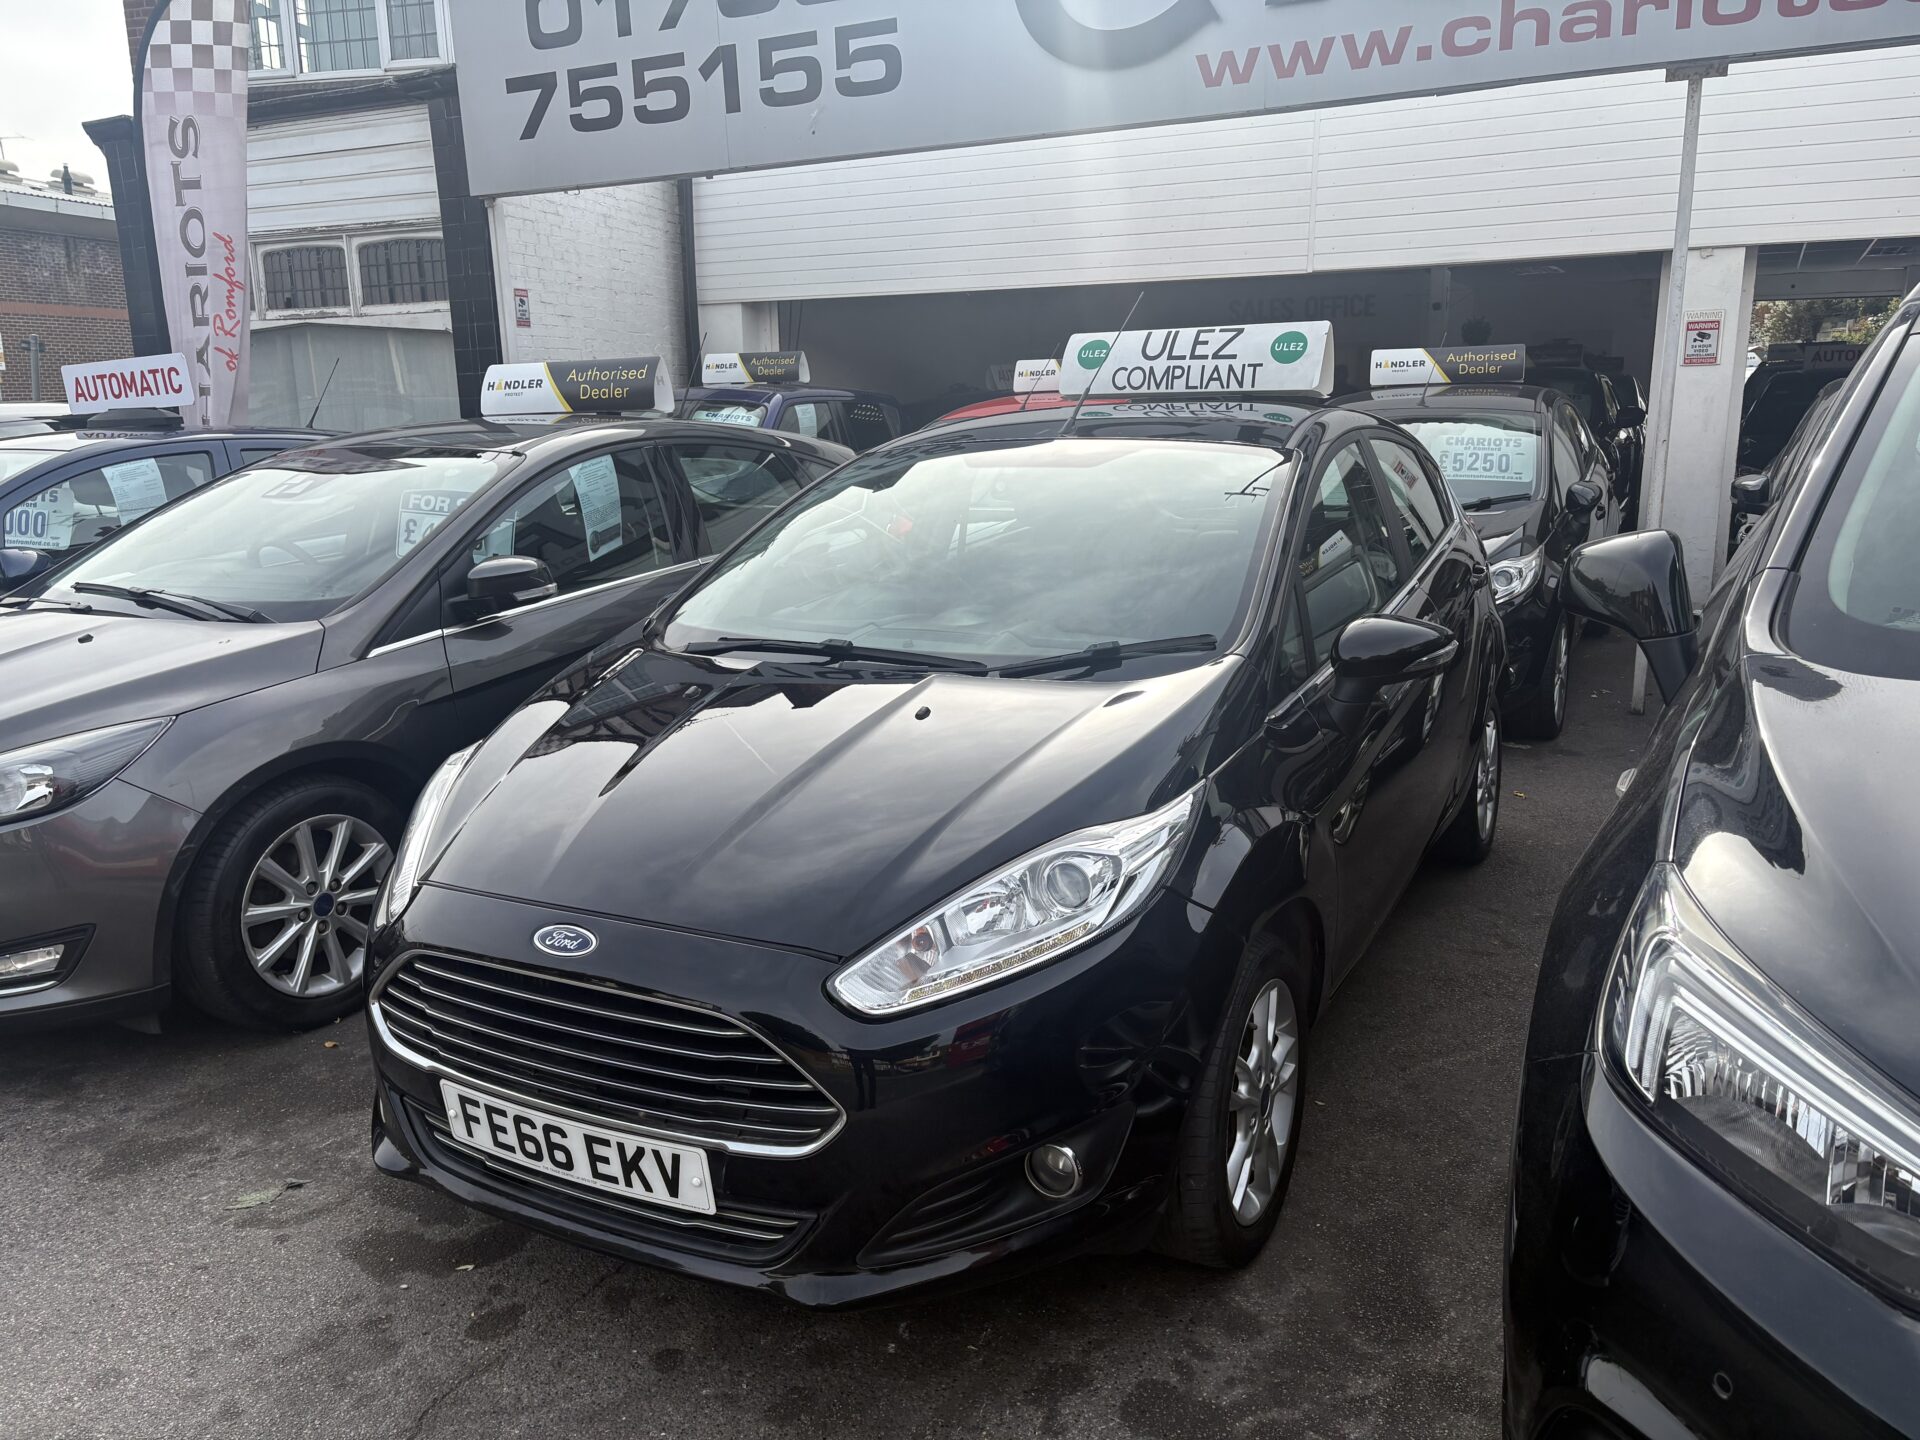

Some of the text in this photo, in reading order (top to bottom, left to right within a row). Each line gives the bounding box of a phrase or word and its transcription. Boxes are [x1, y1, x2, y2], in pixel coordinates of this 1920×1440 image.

[505, 17, 902, 141] 755155
[213, 232, 246, 373] of Romford
[1305, 293, 1377, 318] OFFICE
[1686, 311, 1723, 319] WARNING
[1688, 322, 1719, 330] WARNING
[1141, 327, 1245, 361] ULEZ
[1275, 342, 1304, 351] ULEZ
[1081, 349, 1107, 358] ULEZ
[1446, 350, 1517, 363] Authorised
[705, 362, 738, 370] HANDLER
[750, 355, 796, 366] Authorised
[1375, 360, 1426, 369] HANDLER
[566, 364, 648, 382] Authorised
[757, 366, 786, 376] Dealer
[1018, 369, 1056, 378] HANDLER
[1459, 363, 1502, 375] Dealer
[1111, 363, 1263, 391] COMPLIANT
[75, 366, 183, 403] AUTOMATIC
[487, 379, 543, 391] HANDLER
[580, 384, 629, 400] Dealer
[705, 412, 752, 422] CHARIOTS
[1446, 436, 1522, 448] CHARIOTS
[1439, 452, 1511, 473] £5250
[408, 494, 451, 512] FOR
[545, 930, 583, 950] Ford
[458, 1093, 681, 1200] FE66 EKV
